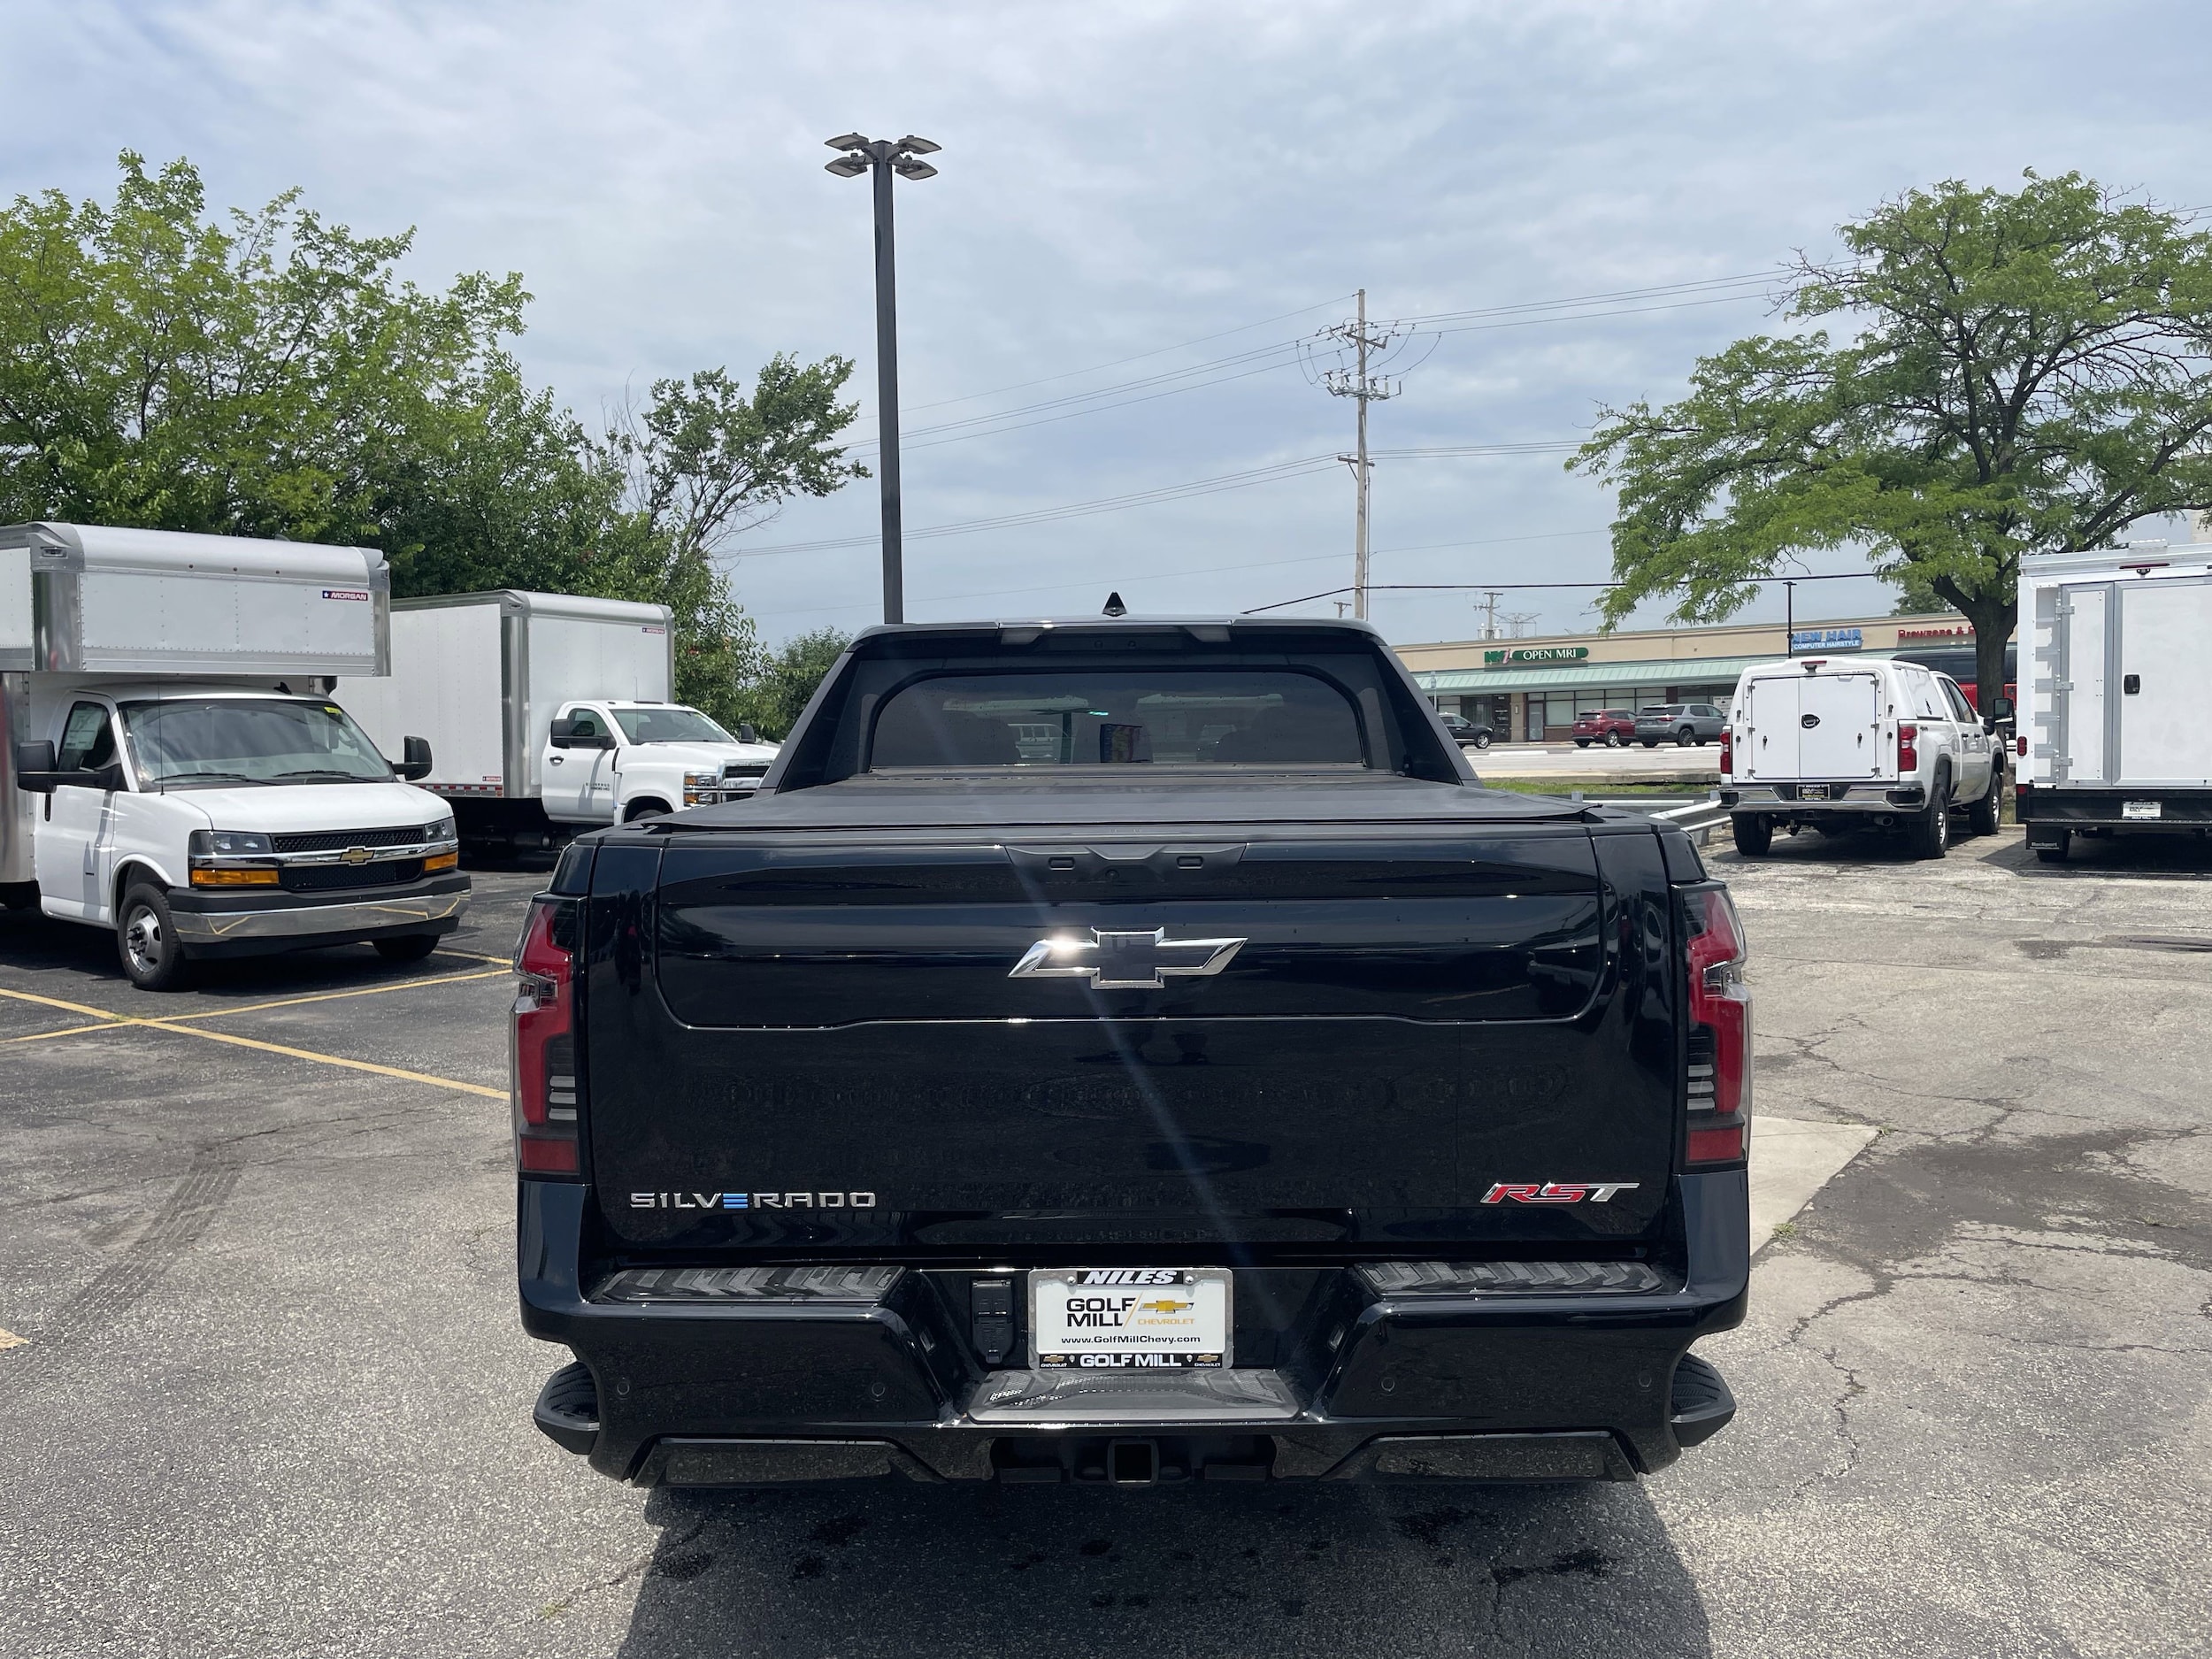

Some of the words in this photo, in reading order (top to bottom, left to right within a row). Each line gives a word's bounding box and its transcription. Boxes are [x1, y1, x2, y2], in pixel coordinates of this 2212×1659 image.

[1793, 631, 1822, 643] NEW
[1826, 628, 1863, 641] HAIR
[1523, 649, 1552, 660] OPEN
[1556, 648, 1577, 658] MRI
[1479, 1182, 1640, 1203] RST
[630, 1192, 876, 1209] SILVERADO
[1082, 1271, 1177, 1284] NILES
[1066, 1297, 1136, 1312] GOLF
[1066, 1313, 1123, 1327] MILL
[1061, 1335, 1201, 1344] www.GolfMillChevy.com
[1079, 1354, 1133, 1367] GOLF
[1134, 1354, 1182, 1367] MILL
